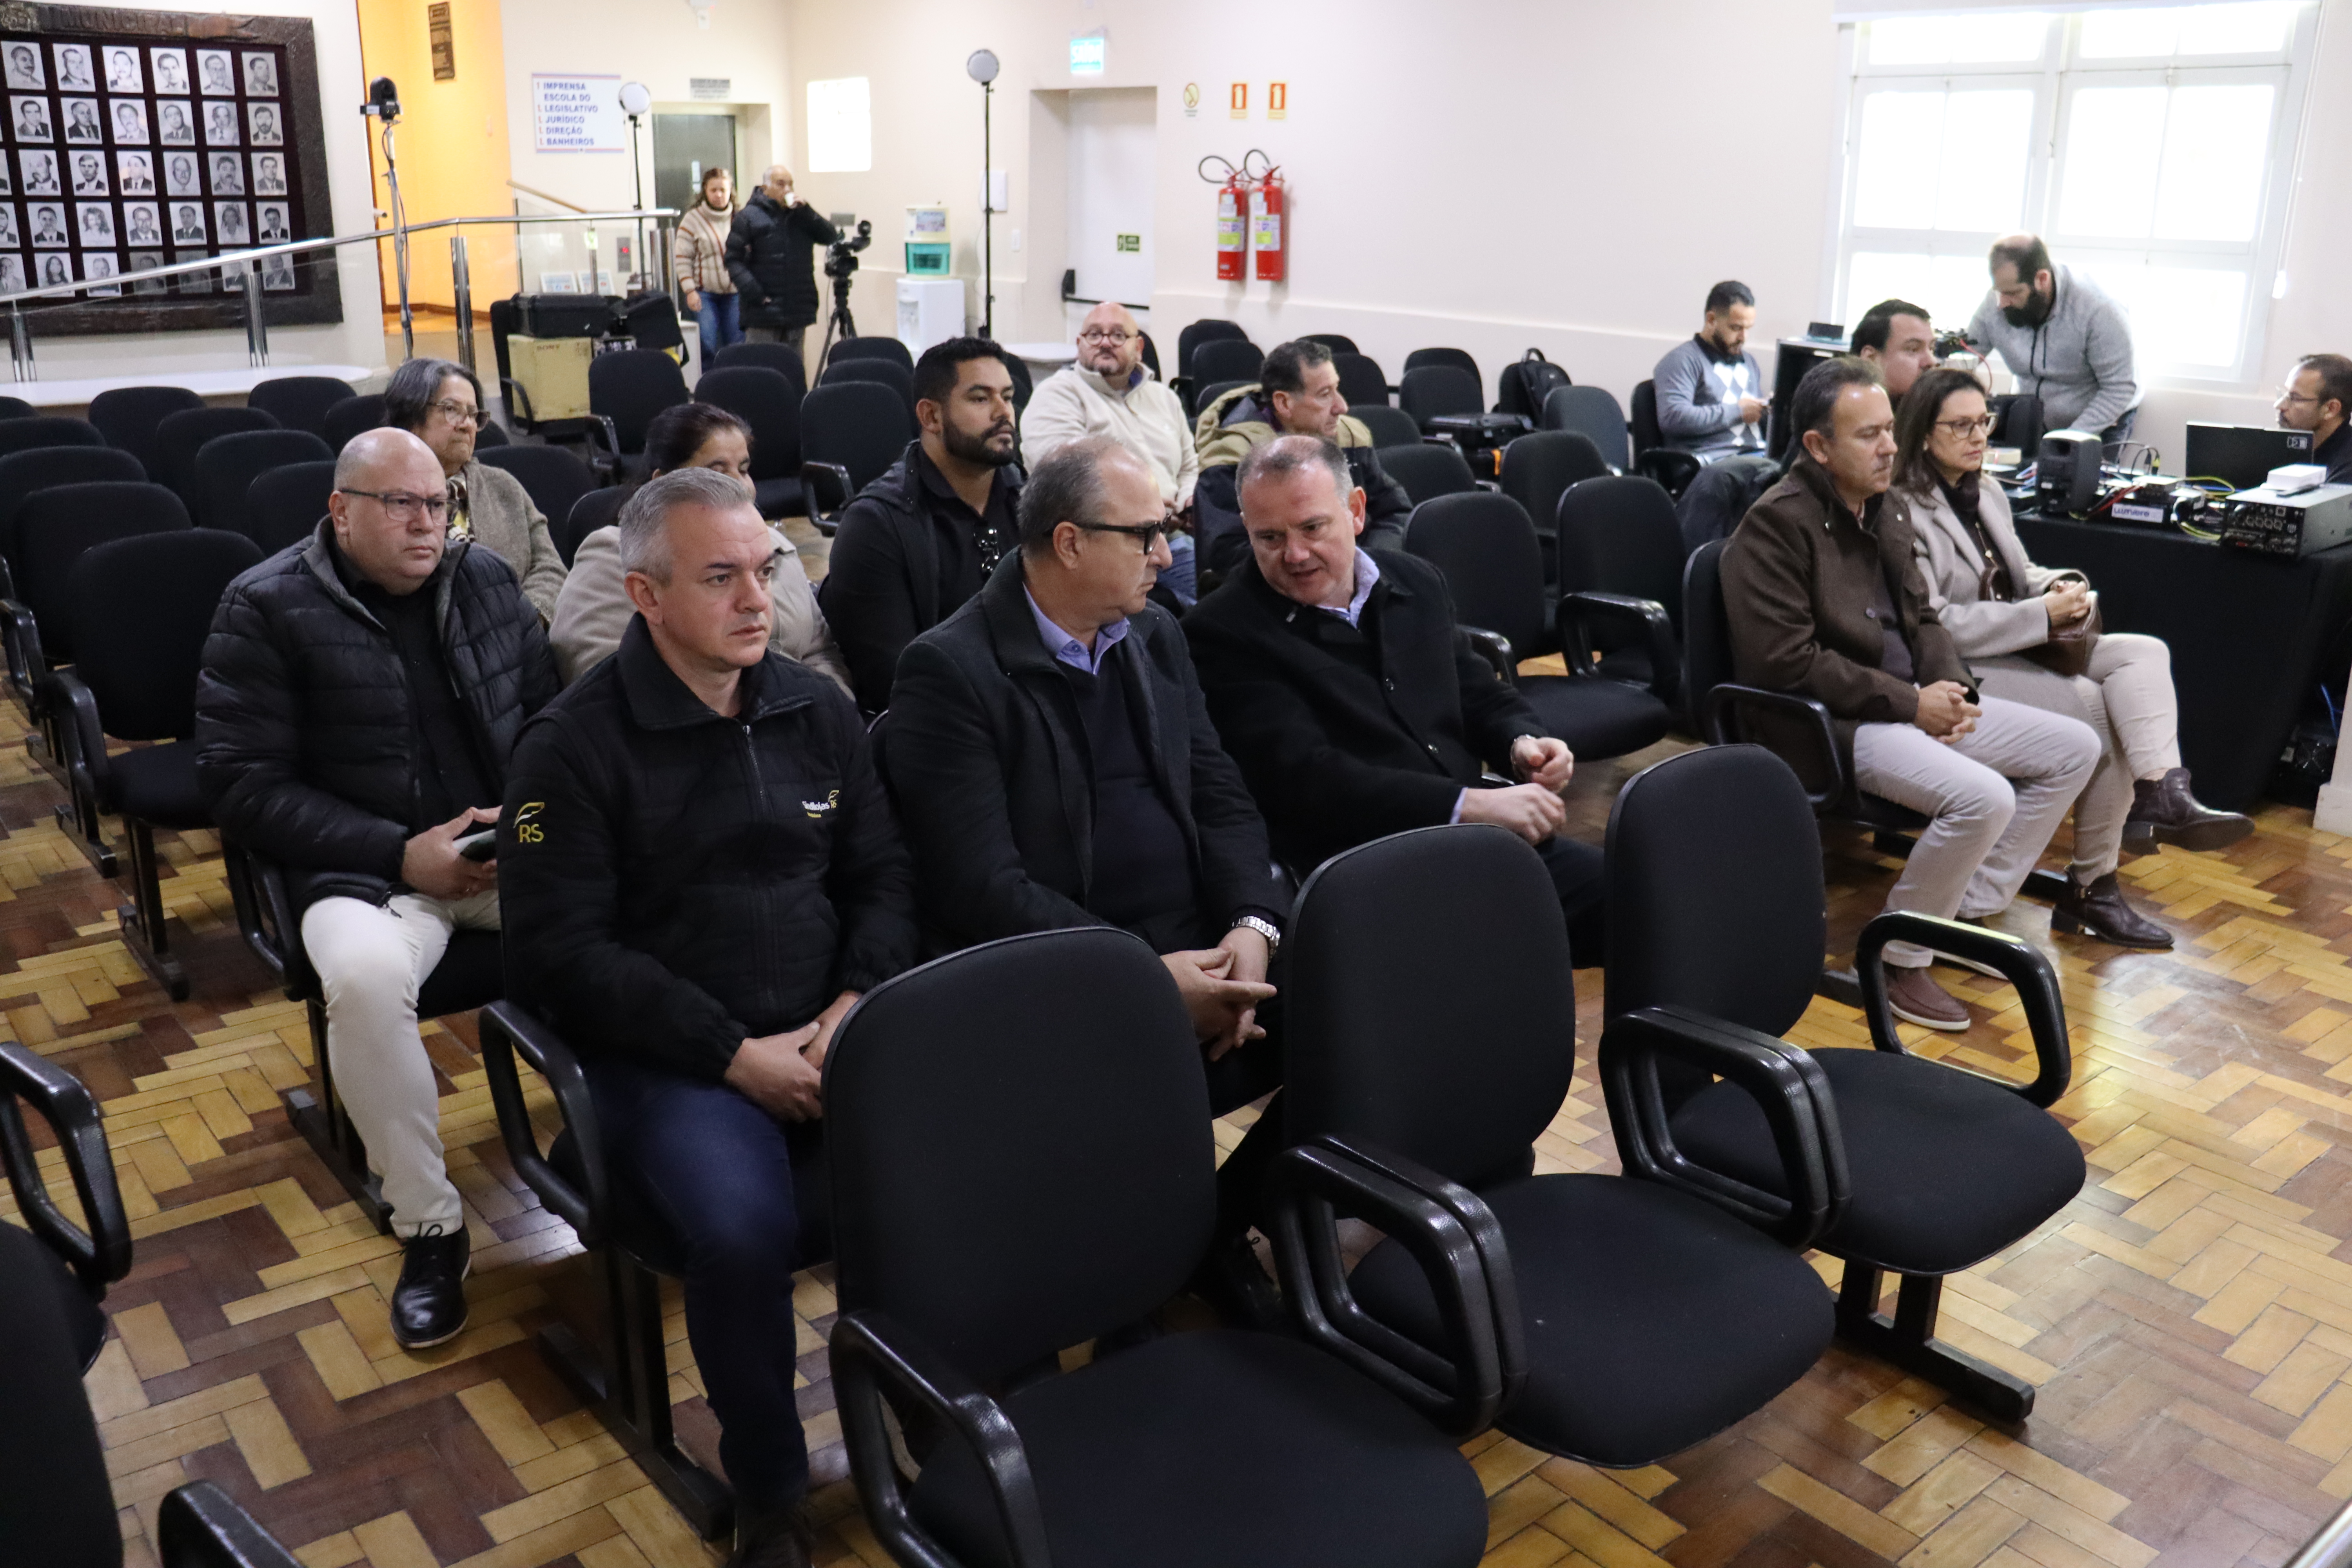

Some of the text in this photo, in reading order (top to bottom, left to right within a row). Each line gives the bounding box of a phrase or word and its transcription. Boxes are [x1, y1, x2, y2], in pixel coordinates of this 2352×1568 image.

[545, 105, 599, 113] LEGISLATIVO
[545, 114, 585, 123] JURÍDICO
[546, 126, 583, 136] DIREÇÃO
[830, 799, 837, 809] RS
[519, 824, 544, 842] RS
